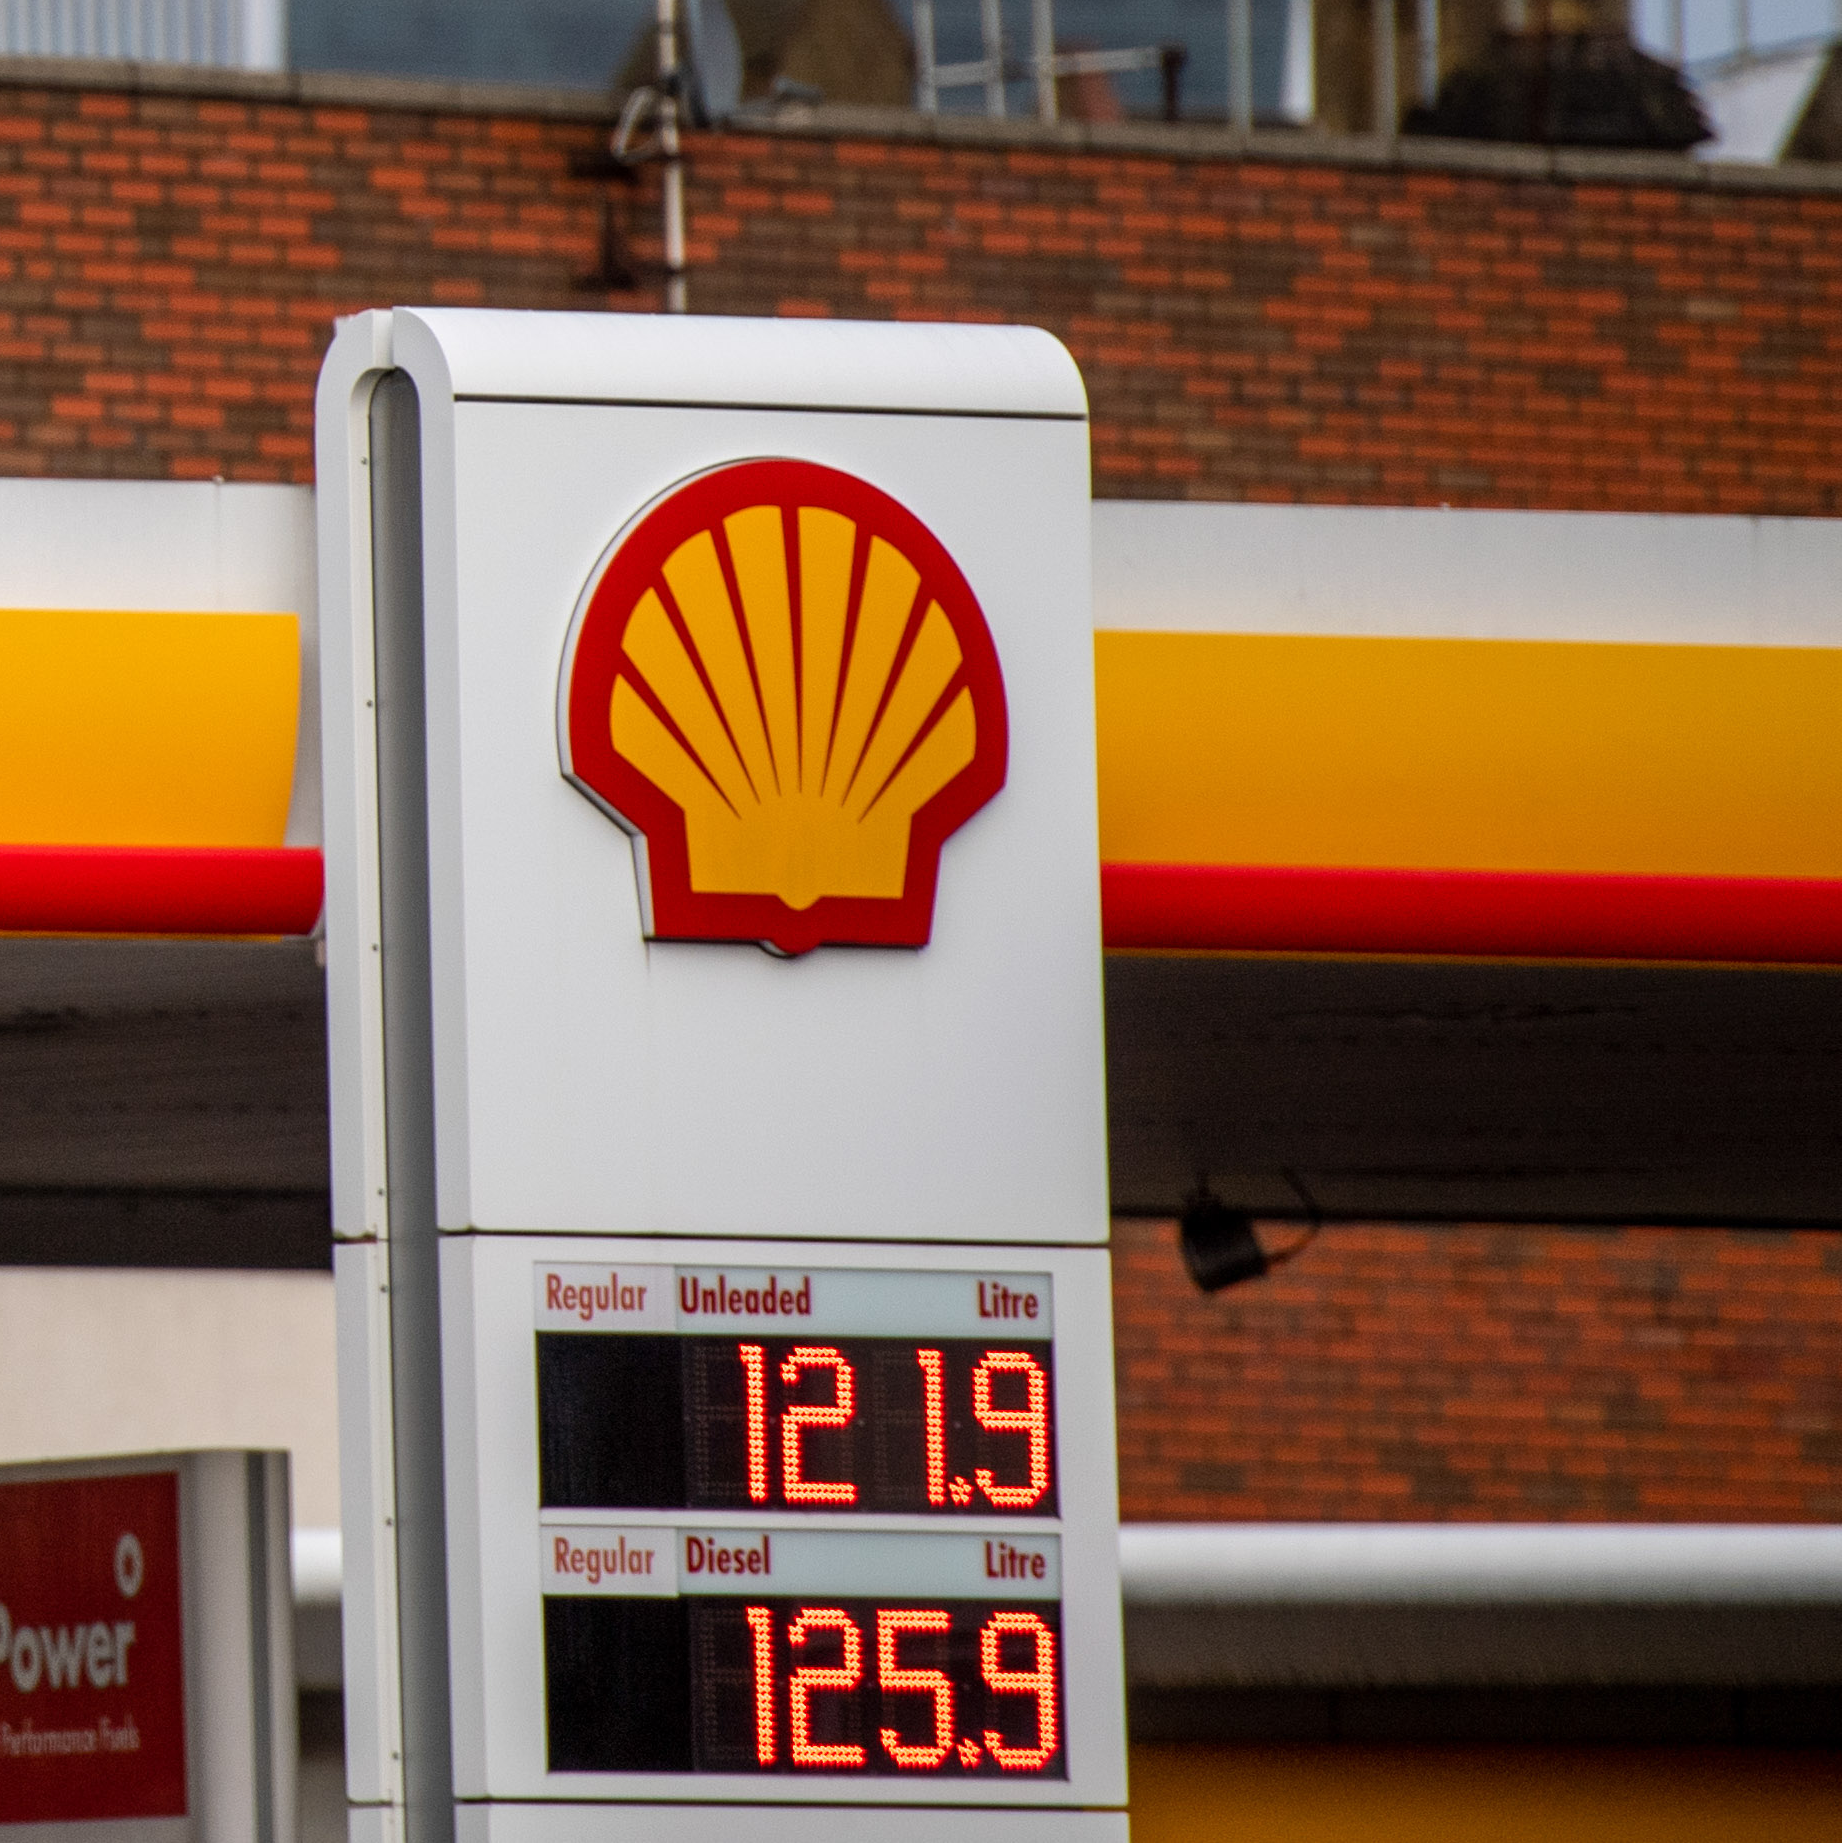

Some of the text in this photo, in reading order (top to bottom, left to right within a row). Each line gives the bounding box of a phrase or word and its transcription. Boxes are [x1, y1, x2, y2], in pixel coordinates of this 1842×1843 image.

[546, 1273, 1039, 1320] Regular Unleaded Litre
[553, 1535, 1046, 1582] Regular Diesel Litre
[746, 1605, 1059, 1770] 125.9
[100, 1715, 140, 1752] Fuels
